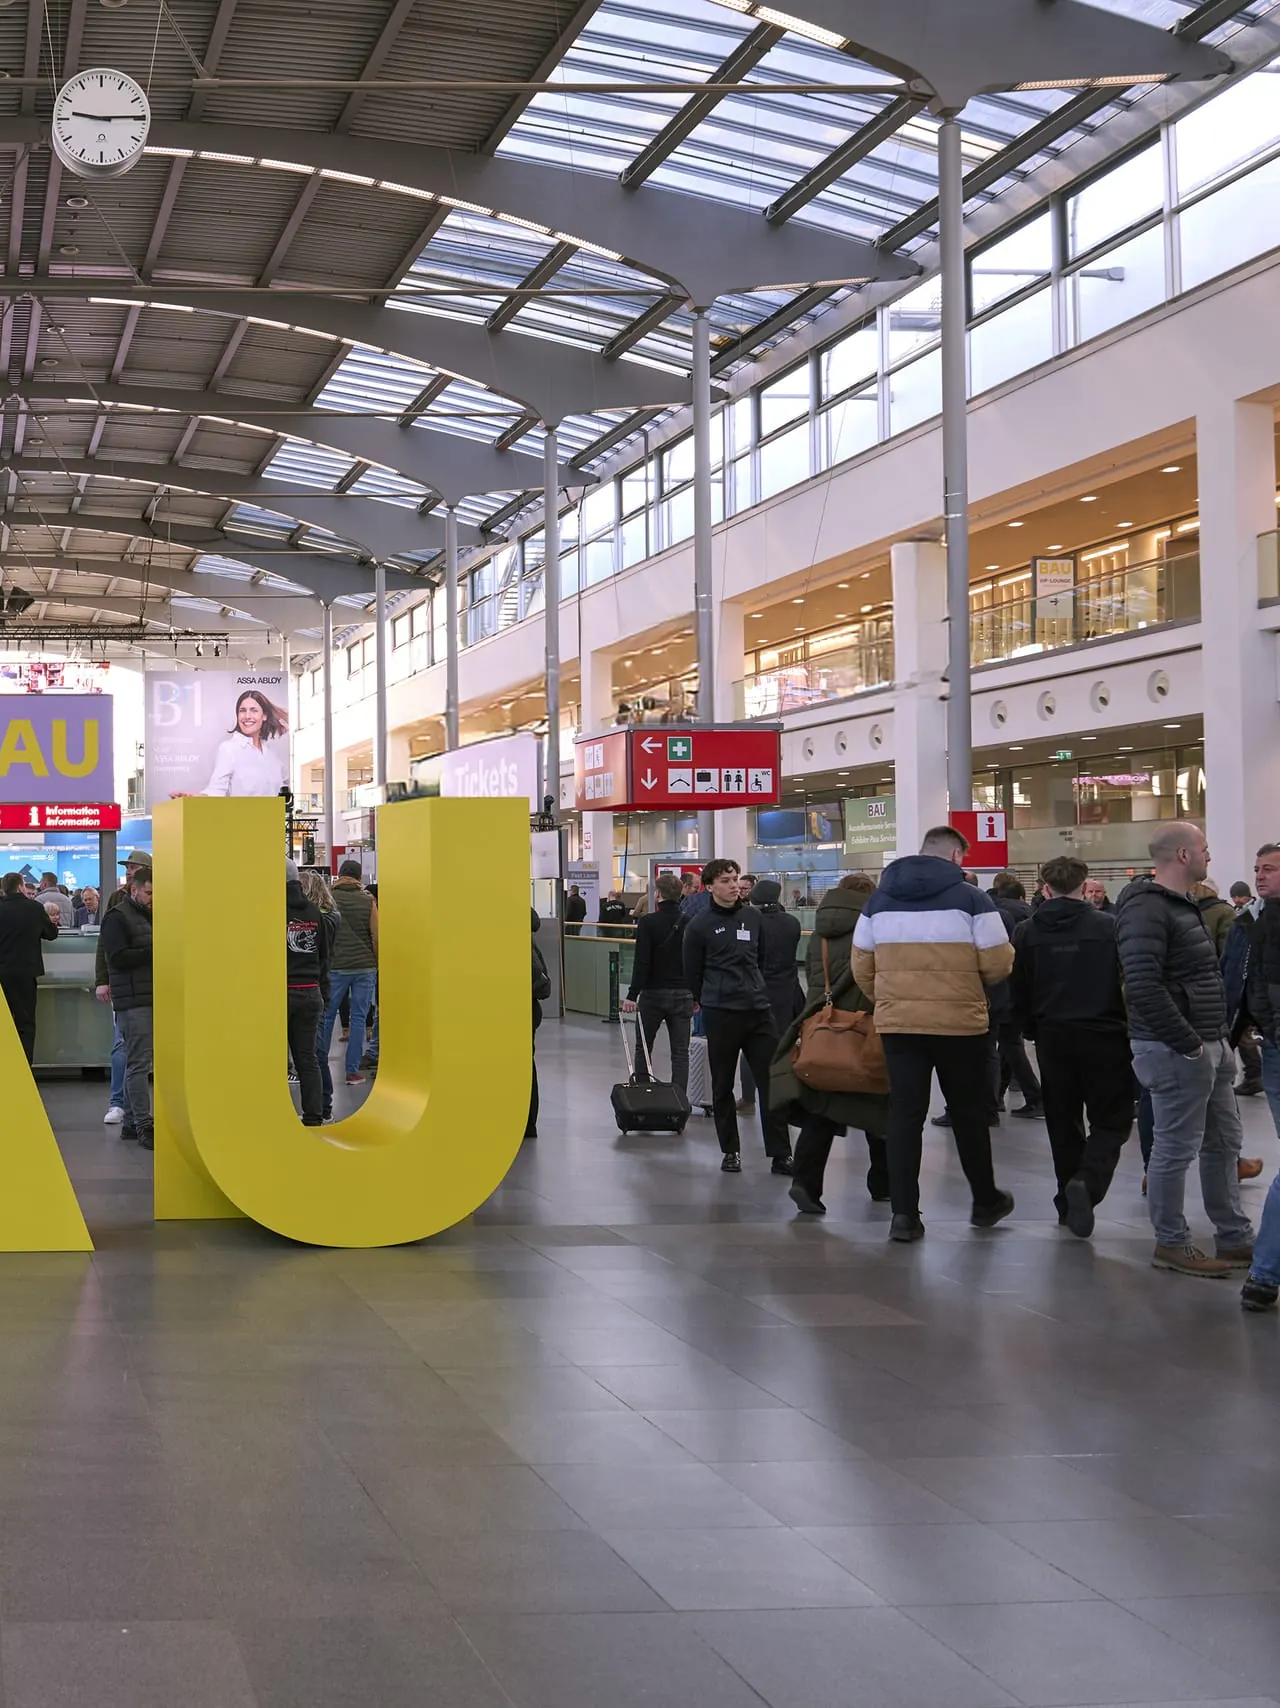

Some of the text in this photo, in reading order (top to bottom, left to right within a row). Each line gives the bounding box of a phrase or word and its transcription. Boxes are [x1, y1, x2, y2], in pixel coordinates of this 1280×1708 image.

[1040, 562, 1071, 575] BAU
[152, 680, 203, 727] B1
[455, 758, 519, 797] Tickets
[45, 806, 100, 816] Information
[868, 803, 886, 816] BAU
[45, 817, 101, 826] Information
